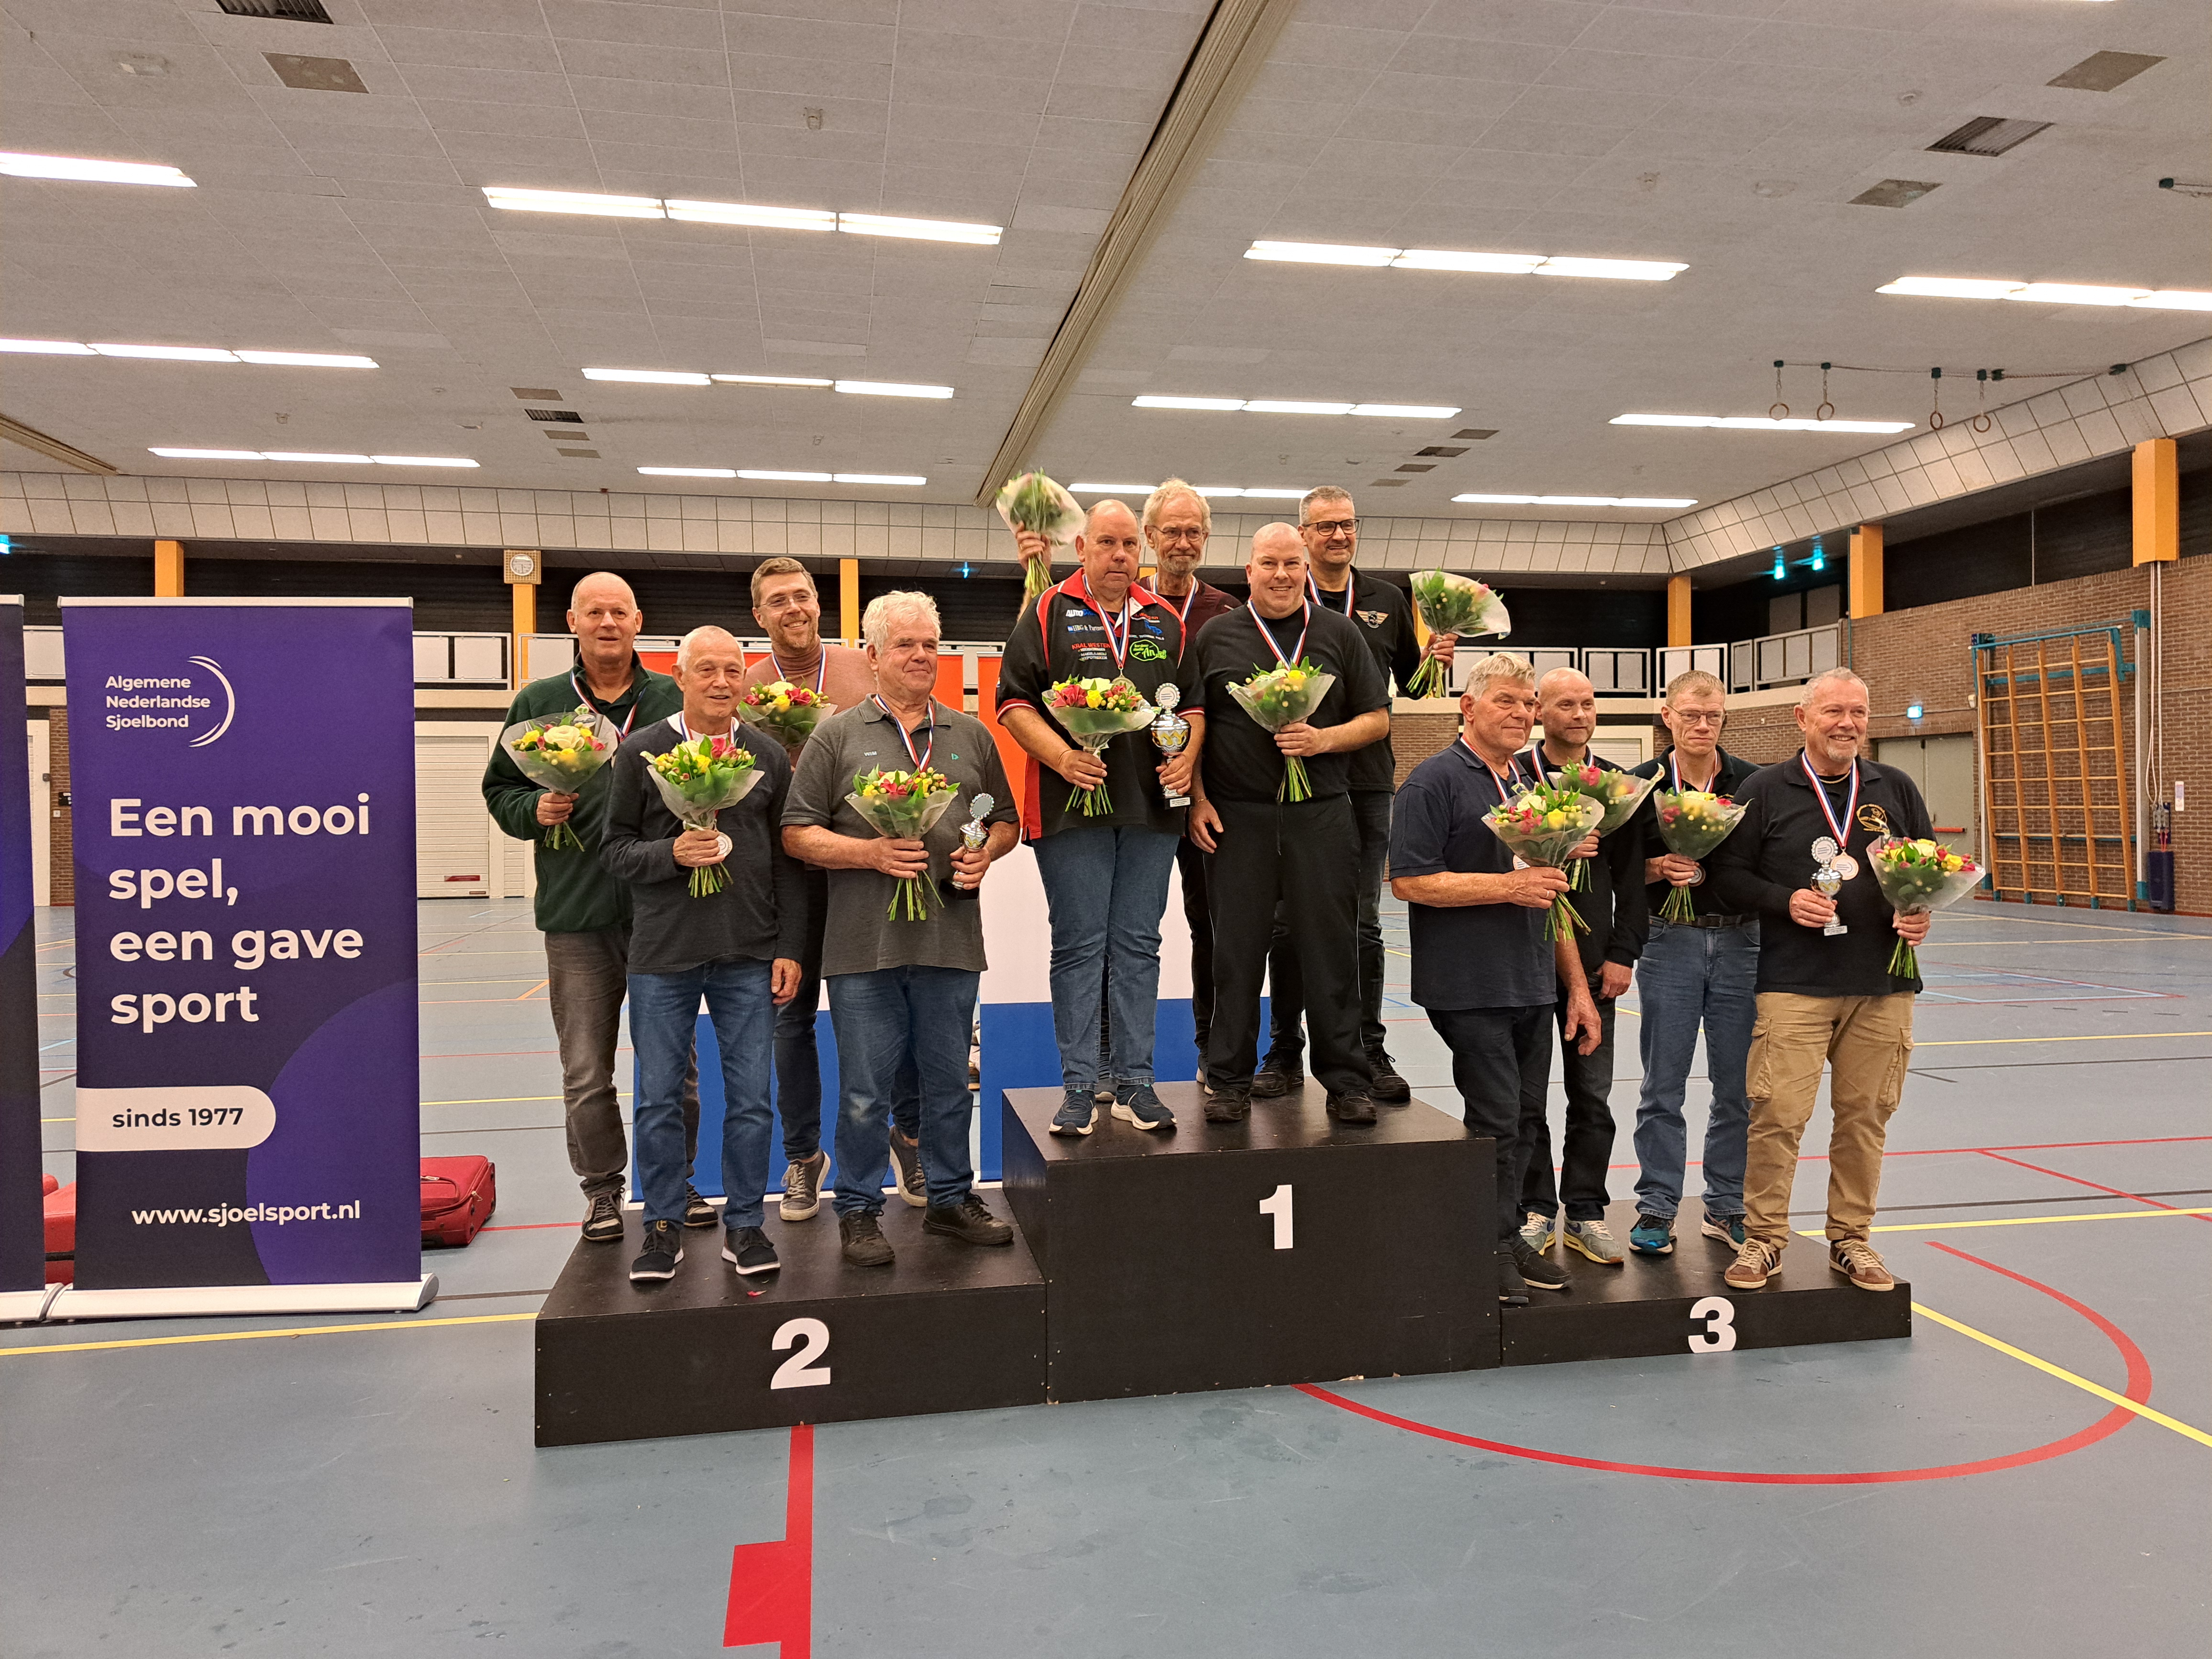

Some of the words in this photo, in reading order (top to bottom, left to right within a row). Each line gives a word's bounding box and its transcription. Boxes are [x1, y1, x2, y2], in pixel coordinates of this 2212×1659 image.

[106, 675, 191, 691] Algemene
[106, 695, 211, 708] Nederlandse
[106, 715, 189, 731] Sjoelbond
[111, 798, 213, 837] Een
[233, 793, 370, 836] mooi
[109, 859, 239, 909] spel,
[110, 931, 213, 962] een
[232, 929, 364, 971] gave
[111, 986, 260, 1033] sport
[113, 1108, 181, 1128] sinds
[188, 1108, 244, 1127] 1977
[132, 1200, 361, 1227] www.sjoelsport.nl
[1260, 1184, 1294, 1250] 1
[1688, 1296, 1737, 1353] 3
[771, 1318, 831, 1390] 2
